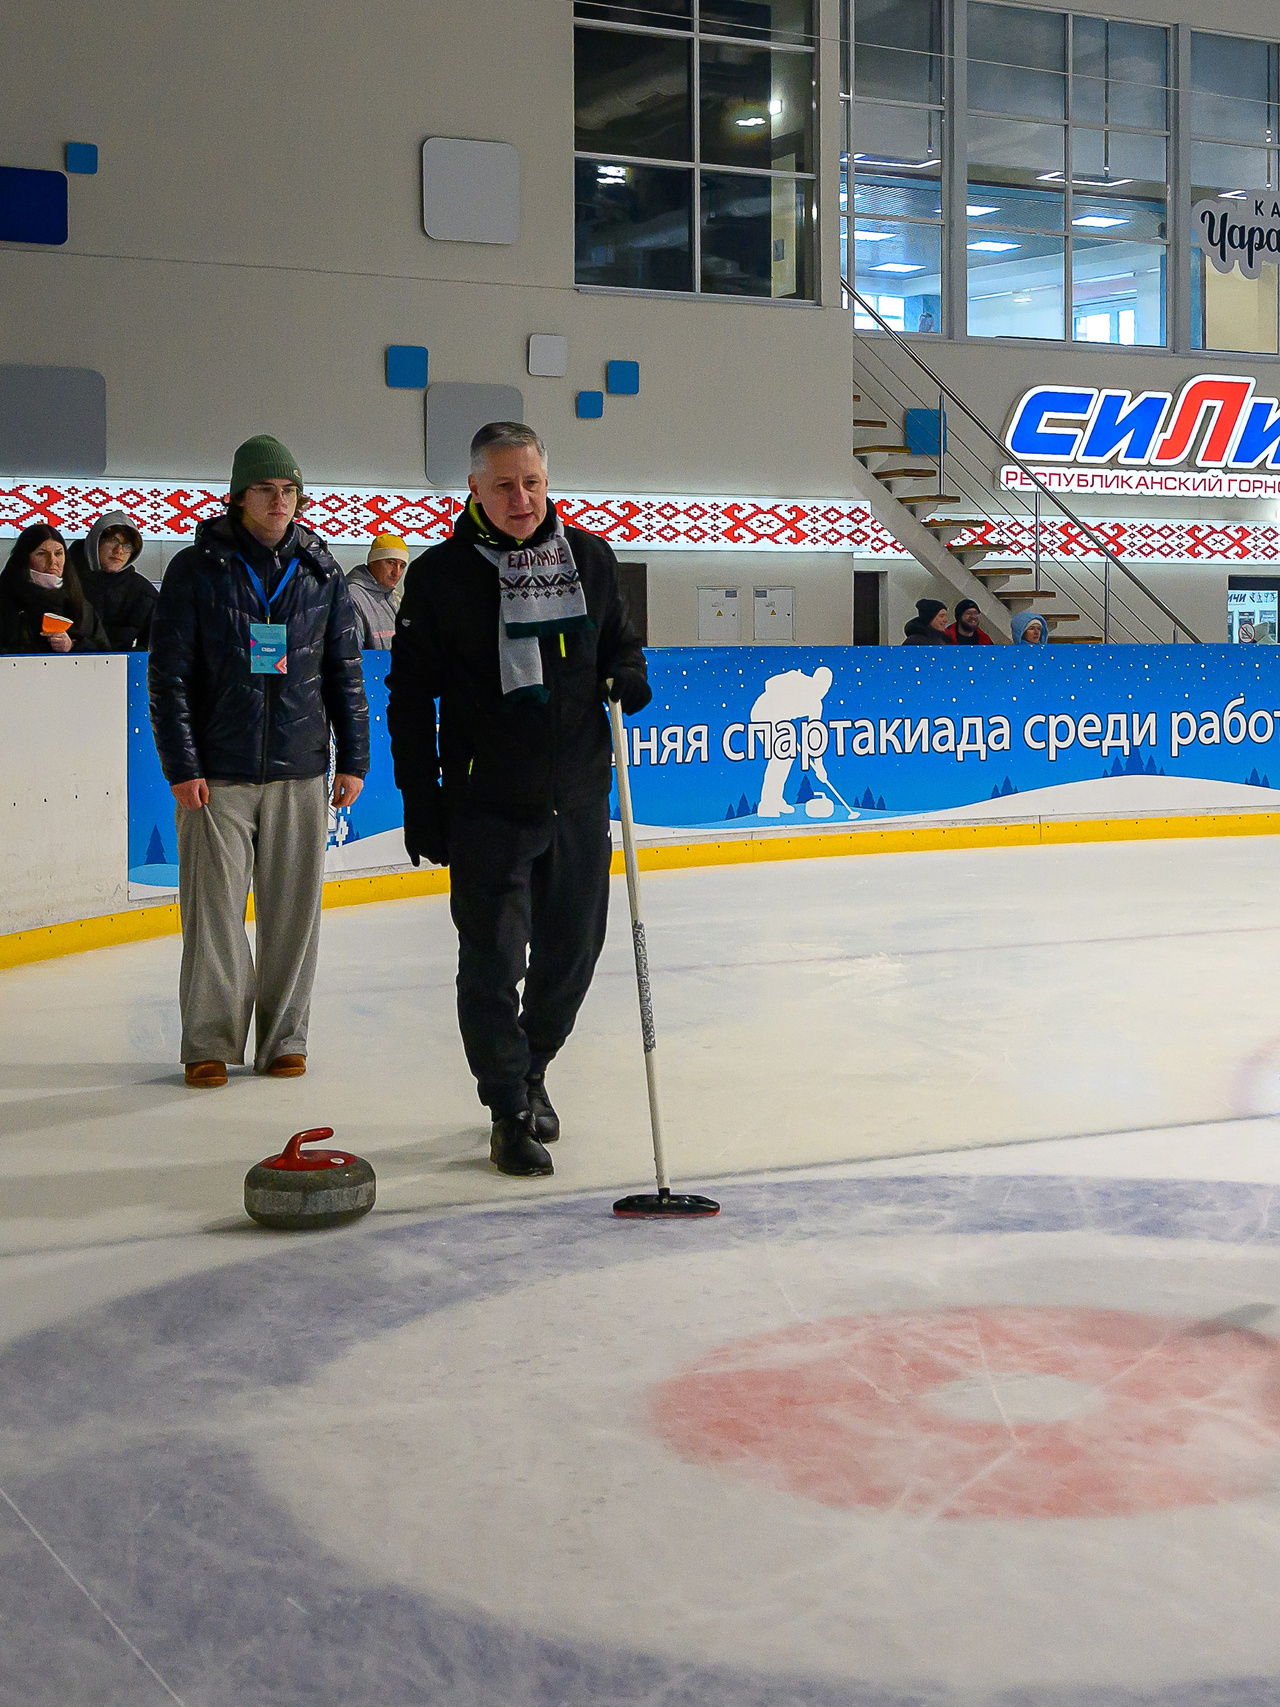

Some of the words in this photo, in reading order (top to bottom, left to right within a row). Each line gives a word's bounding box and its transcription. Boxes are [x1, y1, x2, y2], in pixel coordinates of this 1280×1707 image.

[1005, 470, 1223, 493] РЕСПУБЛИКАНСКИЙ
[722, 714, 1011, 771] спартакиада
[1023, 708, 1157, 761] среди
